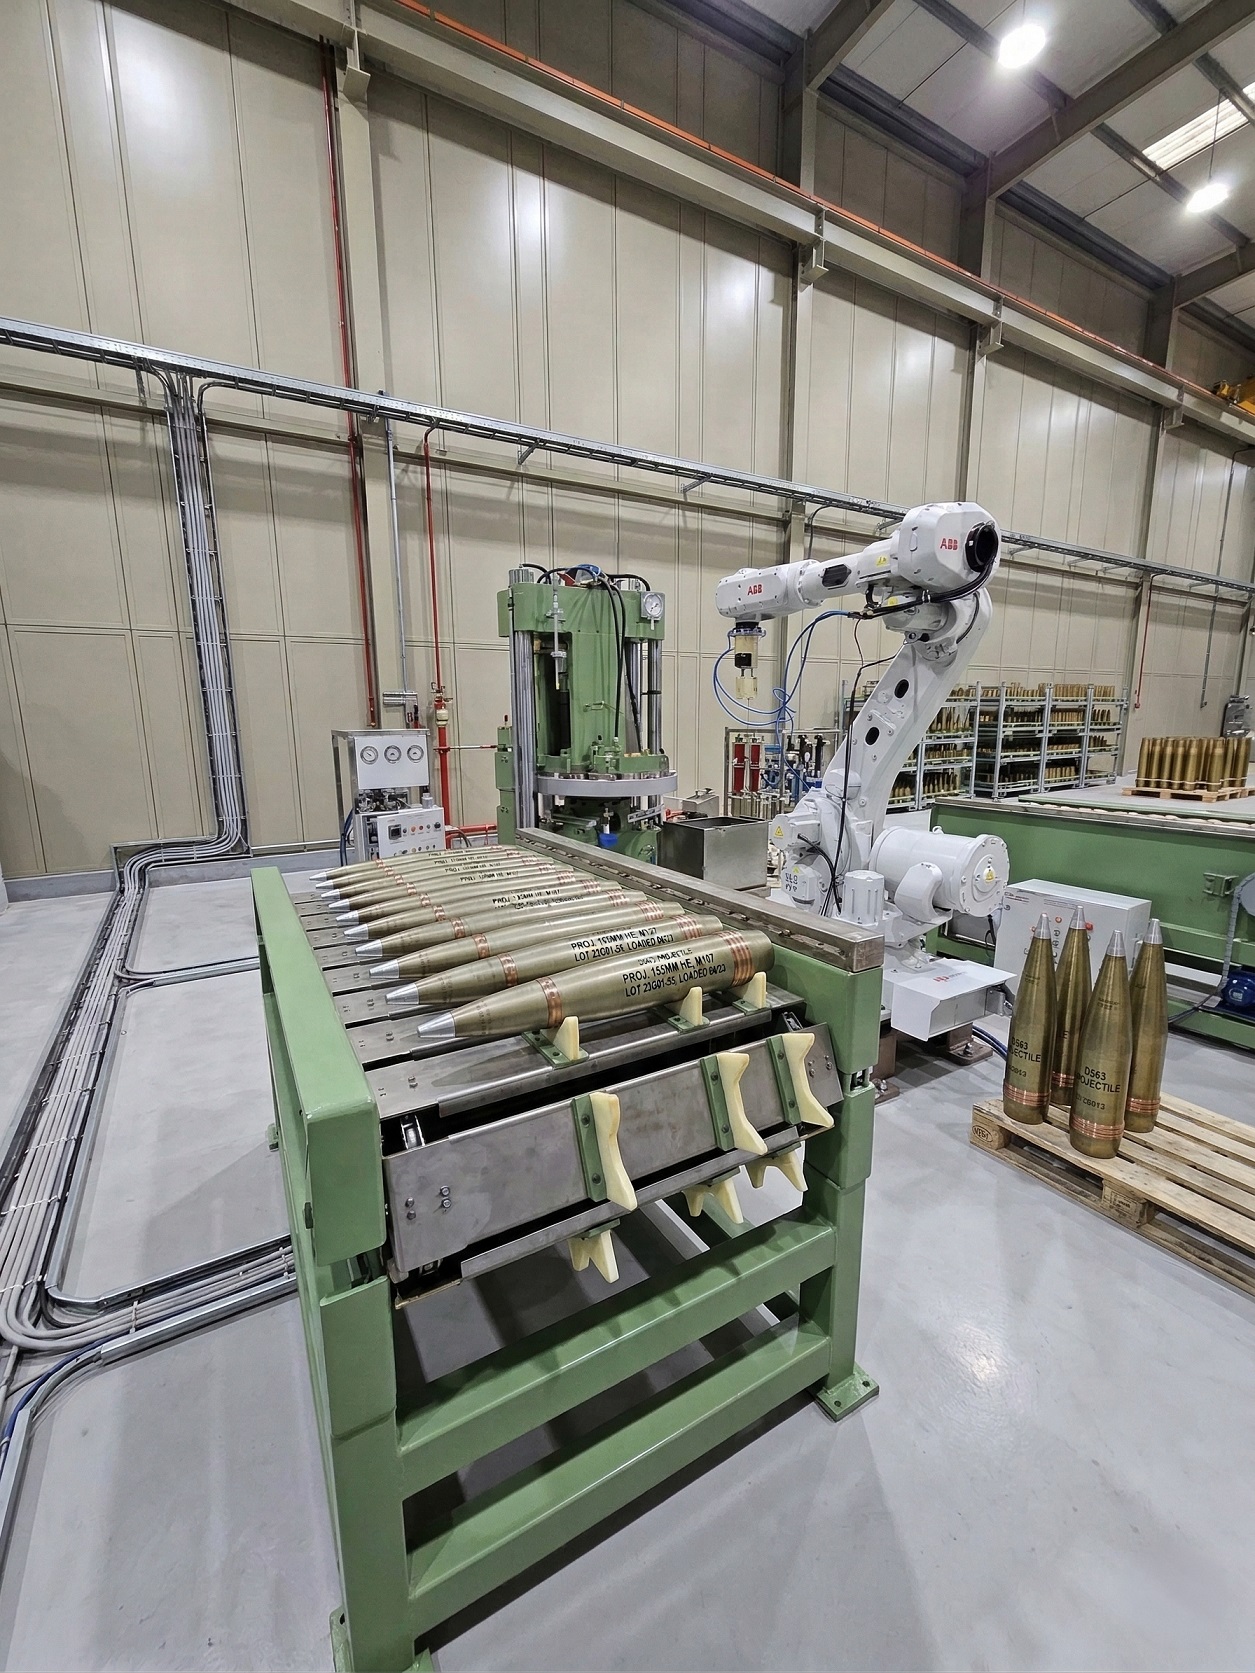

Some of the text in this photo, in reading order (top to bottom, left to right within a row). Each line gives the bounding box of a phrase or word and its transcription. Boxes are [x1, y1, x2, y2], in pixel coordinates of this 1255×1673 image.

[939, 537, 958, 551] ABB
[747, 584, 763, 596] ABB
[574, 950, 590, 962] LOT
[622, 968, 650, 984] PROJ.
[650, 960, 680, 977] 155MM
[694, 953, 714, 967] M107
[625, 984, 641, 998] LOT
